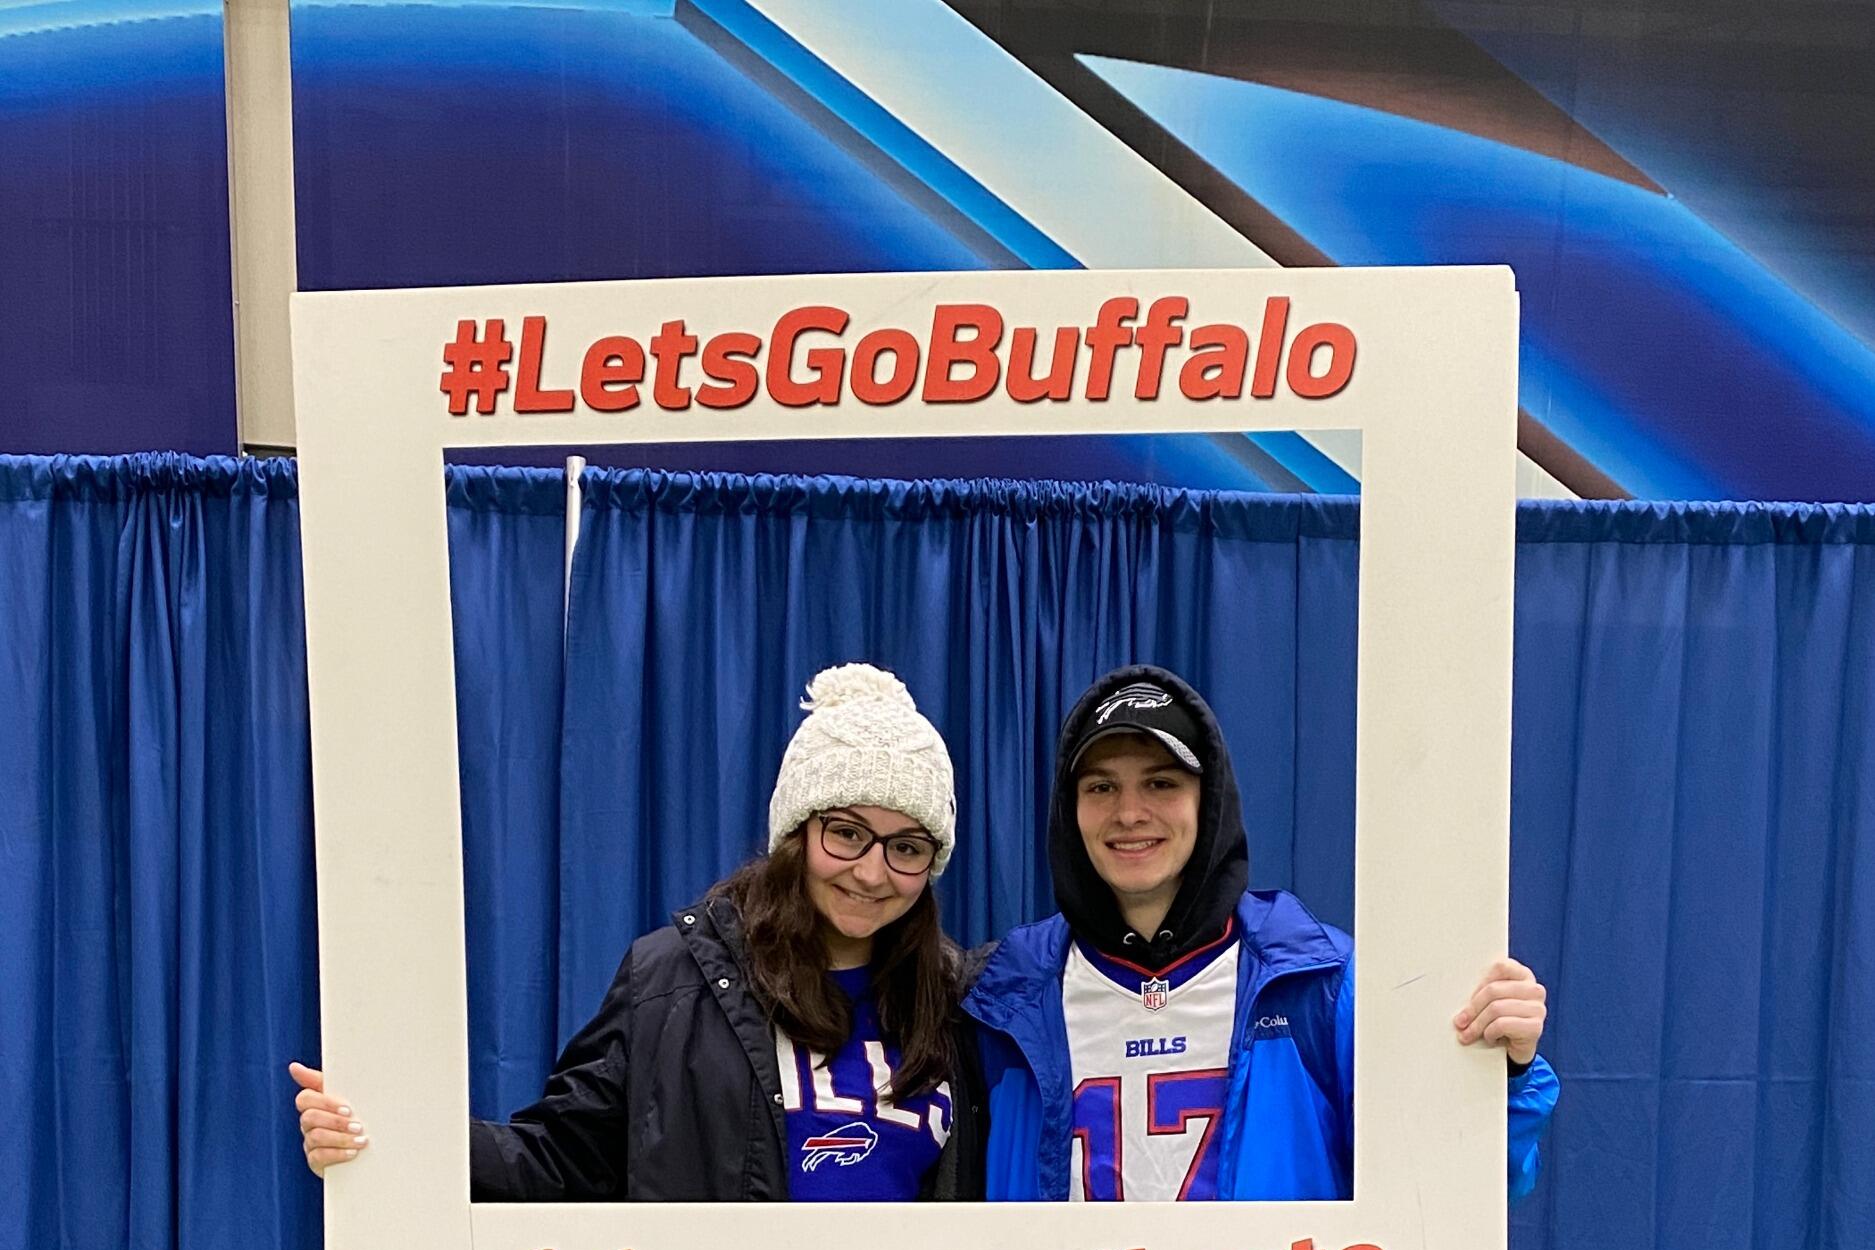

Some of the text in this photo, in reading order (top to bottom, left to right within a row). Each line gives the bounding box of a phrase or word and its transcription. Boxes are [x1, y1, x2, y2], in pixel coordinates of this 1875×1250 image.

[439, 295, 1358, 415] #LetsGoBuffalo
[1145, 993, 1165, 1008] NFL
[1126, 1036, 1187, 1058] BILLS
[1072, 1068, 1226, 1202] 17
